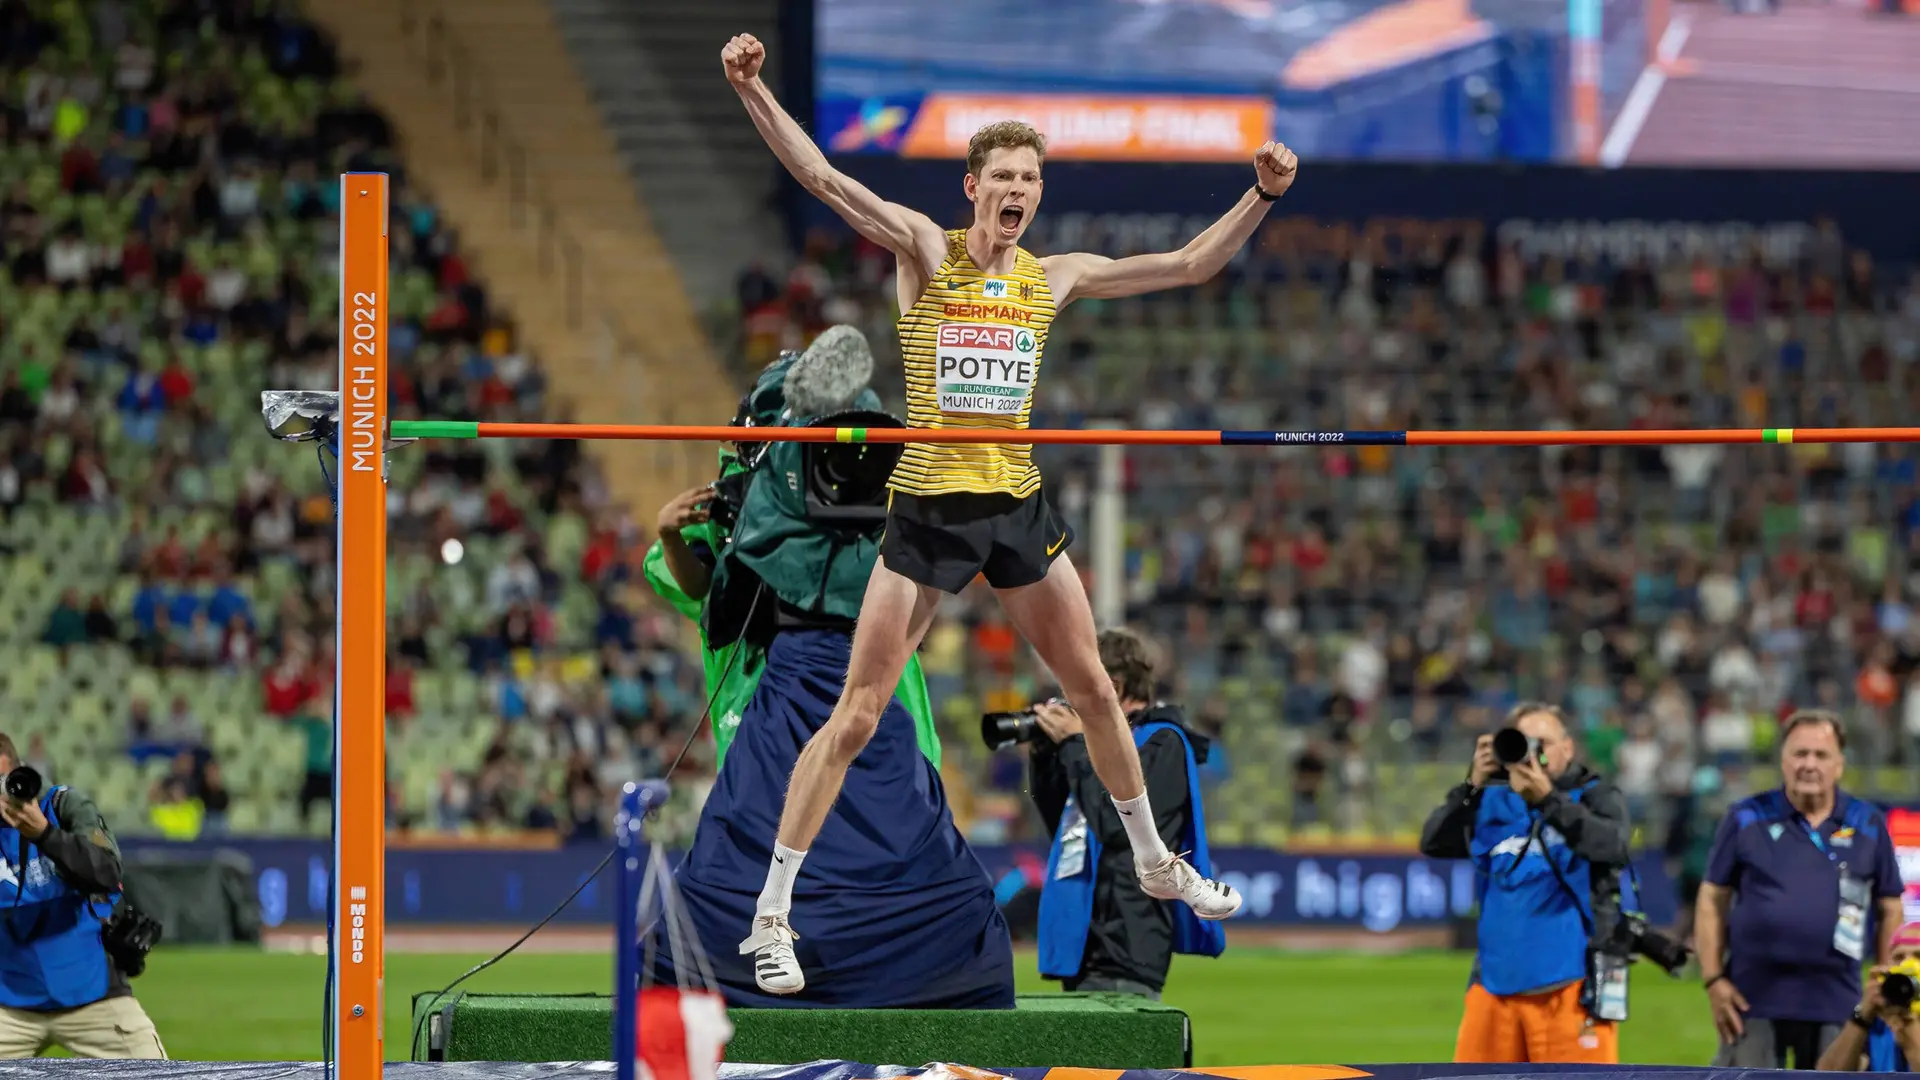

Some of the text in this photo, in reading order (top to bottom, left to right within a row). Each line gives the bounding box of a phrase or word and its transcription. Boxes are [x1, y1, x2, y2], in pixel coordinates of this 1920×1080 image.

[943, 302, 1033, 323] GERMANY
[942, 328, 1012, 348] SPAR
[940, 356, 1031, 383] POTYE
[352, 291, 376, 472] MUNICH 2022
[964, 385, 983, 393] RUN
[943, 396, 1021, 410] MUNICH 2022
[1275, 432, 1344, 442] MUNICH 2022
[350, 903, 366, 964] MONDO
